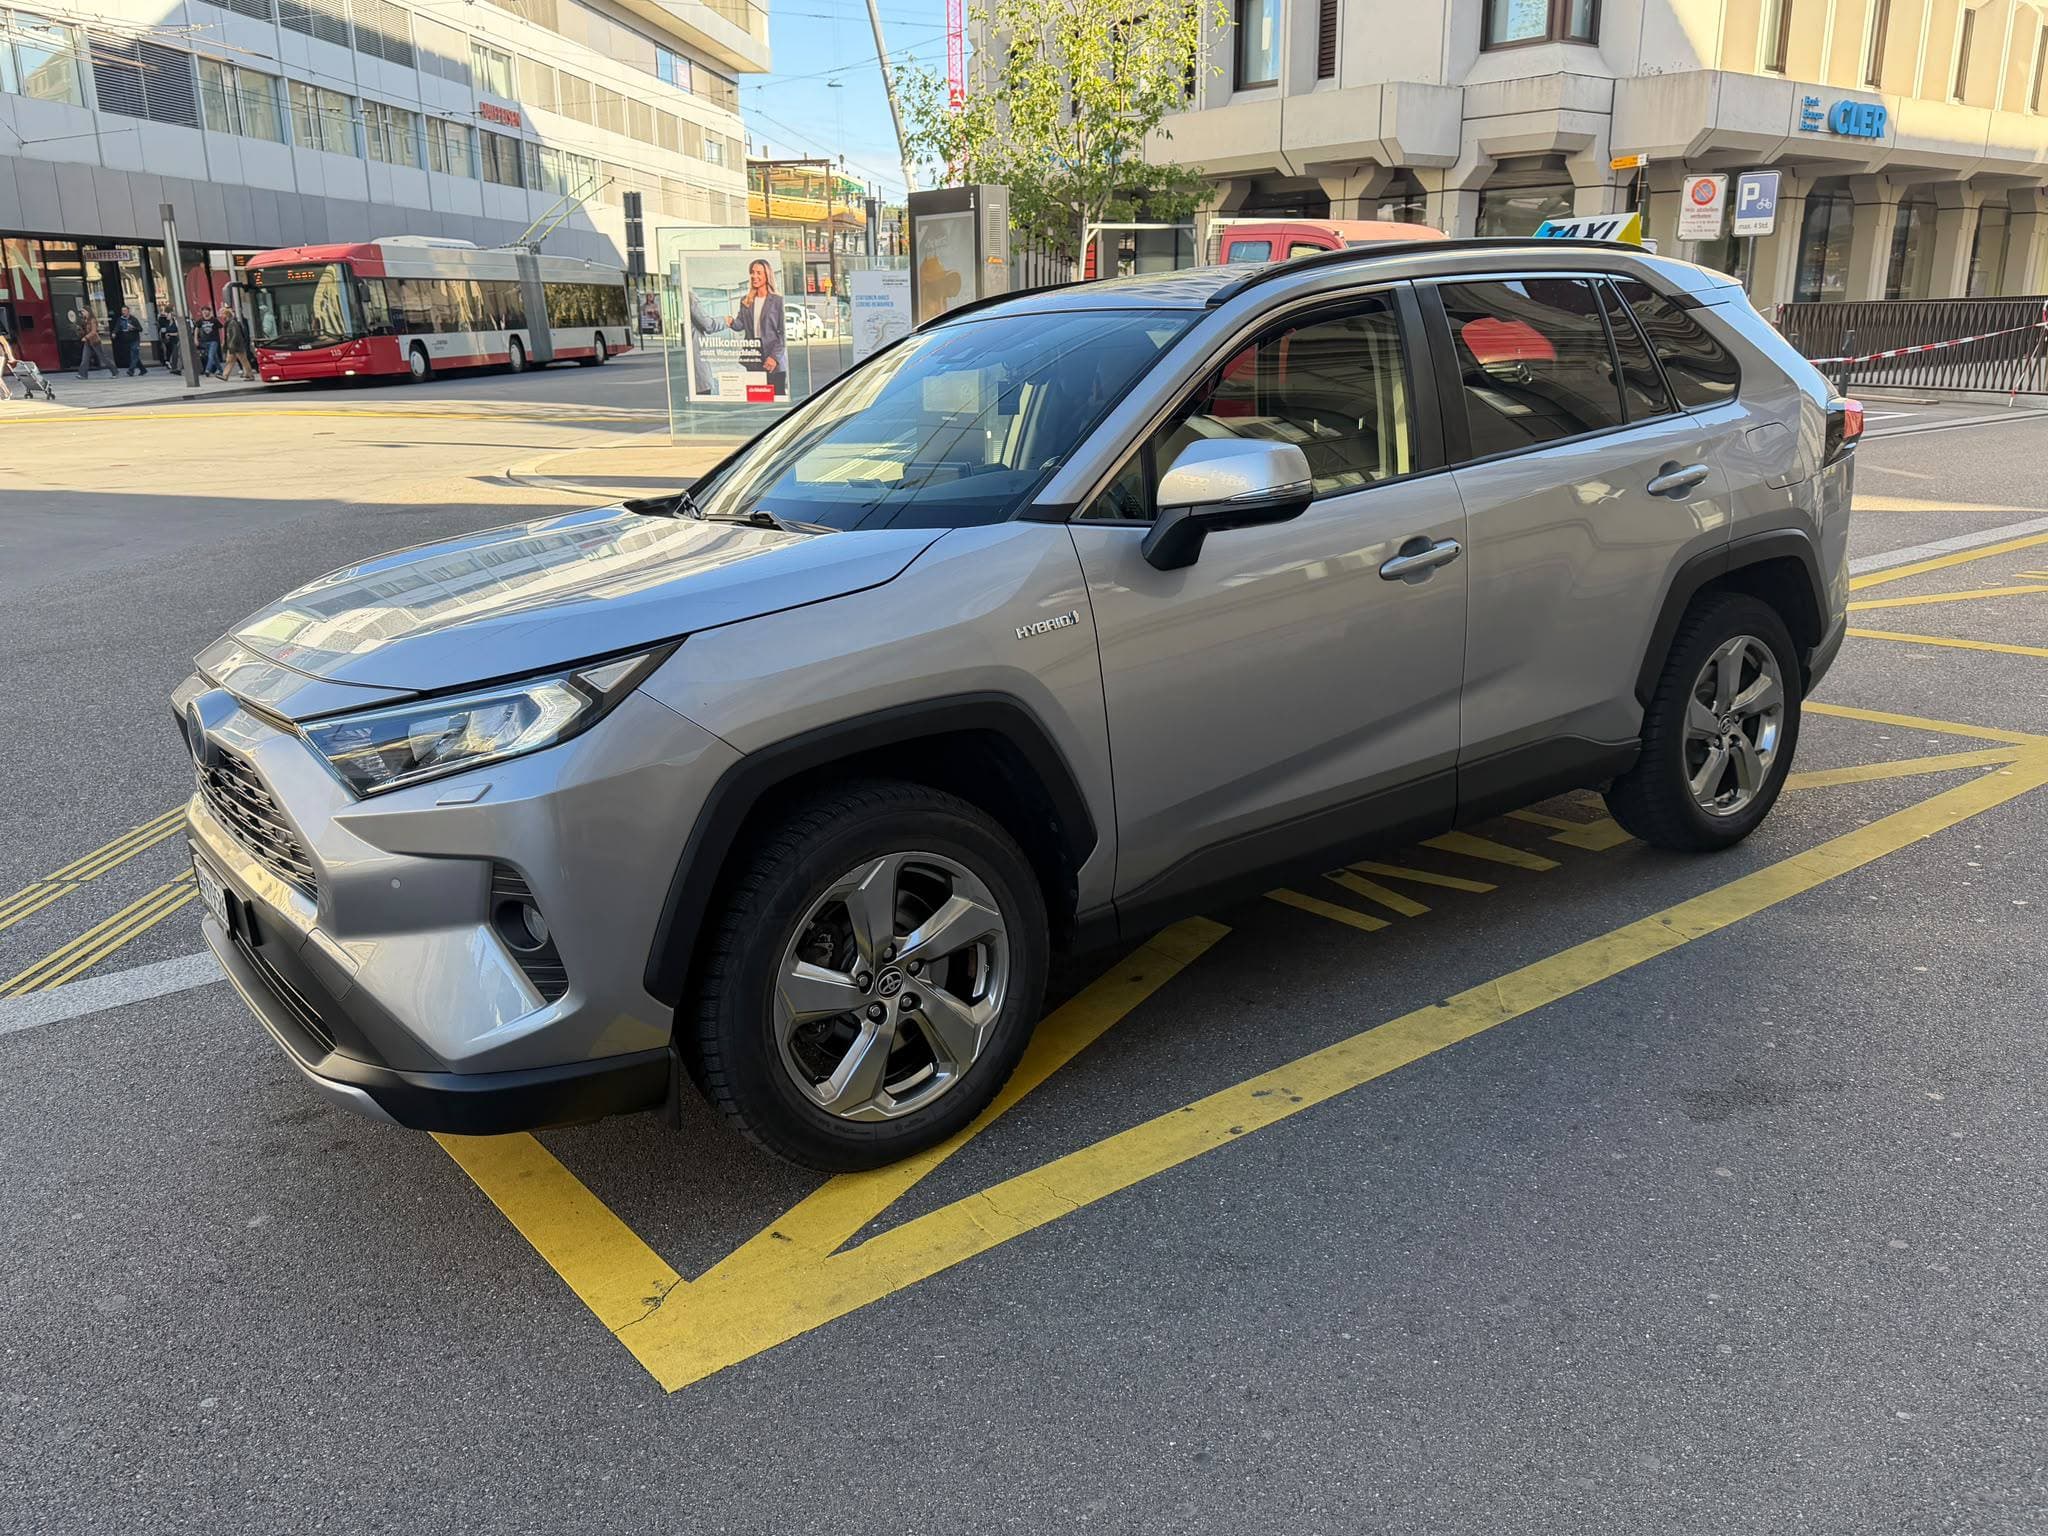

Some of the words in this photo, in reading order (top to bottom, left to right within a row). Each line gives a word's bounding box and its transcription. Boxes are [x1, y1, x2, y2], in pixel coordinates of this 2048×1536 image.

[1829, 100, 1887, 137] CLER
[1741, 183, 1760, 210] P
[1547, 221, 1619, 239] TAXI
[85, 250, 129, 260] RAIFFEISEN
[698, 336, 761, 348] Willkommen
[1015, 615, 1070, 639] HYBRID
